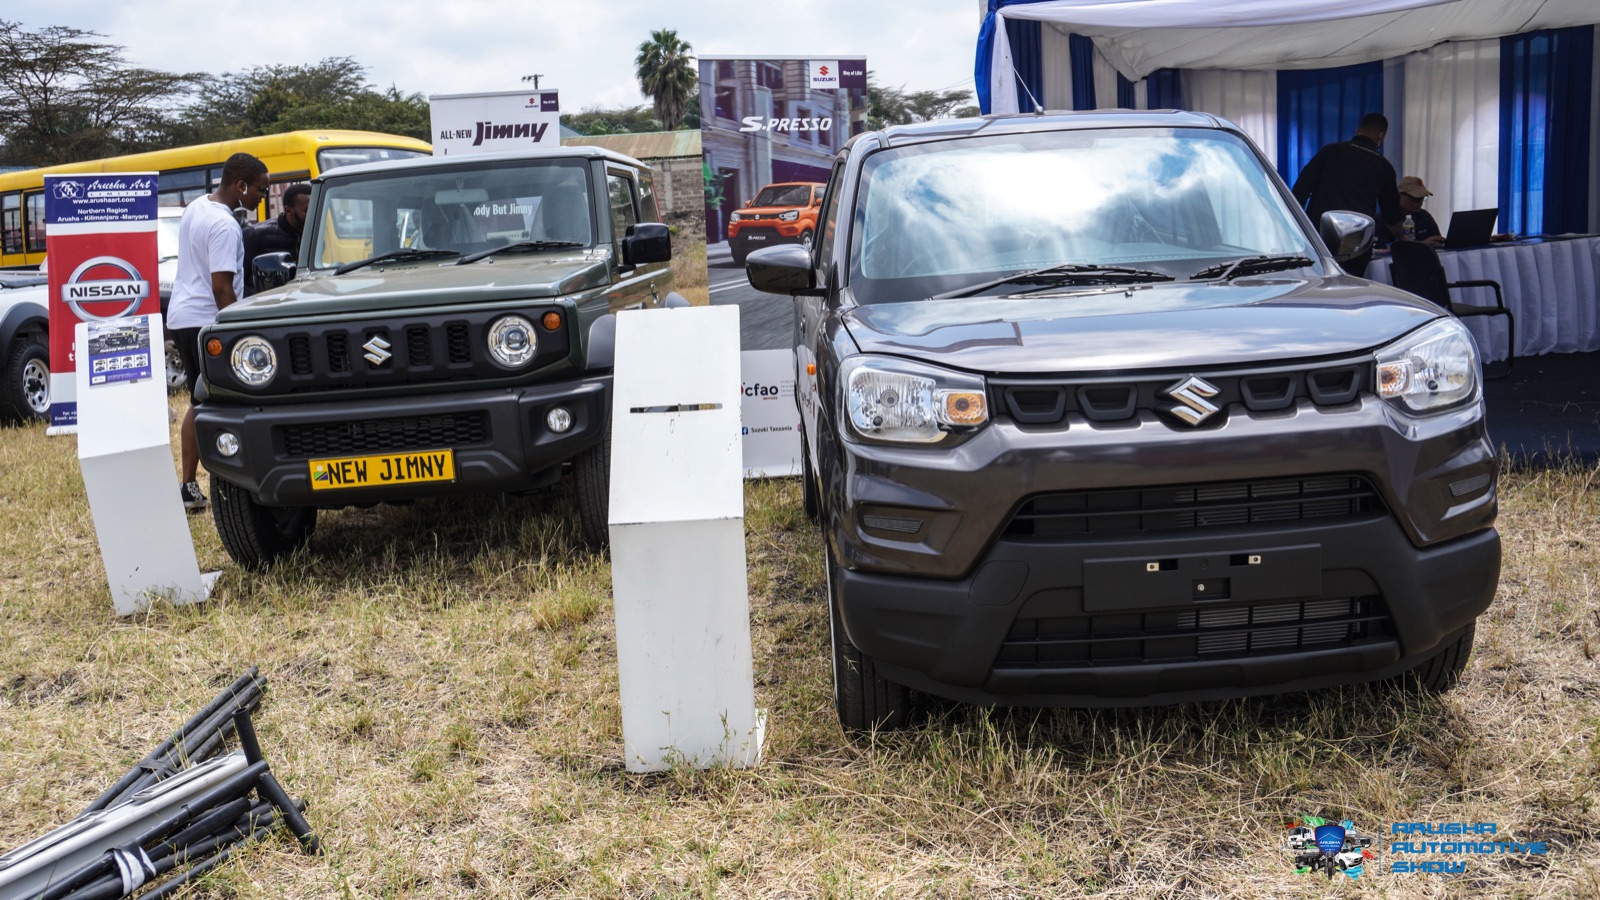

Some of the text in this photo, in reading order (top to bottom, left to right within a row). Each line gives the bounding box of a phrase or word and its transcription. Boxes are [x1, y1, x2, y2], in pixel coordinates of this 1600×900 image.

[440, 121, 549, 146] ALL-NEW Jimny
[87, 179, 151, 190] Arusha Art
[106, 207, 129, 215] Region
[473, 203, 533, 217] ody But Jimny
[84, 214, 119, 222] Kilimanjaro
[70, 284, 140, 298] NISSAN
[745, 383, 779, 397] cfao
[327, 454, 445, 485] NEW JIMNY
